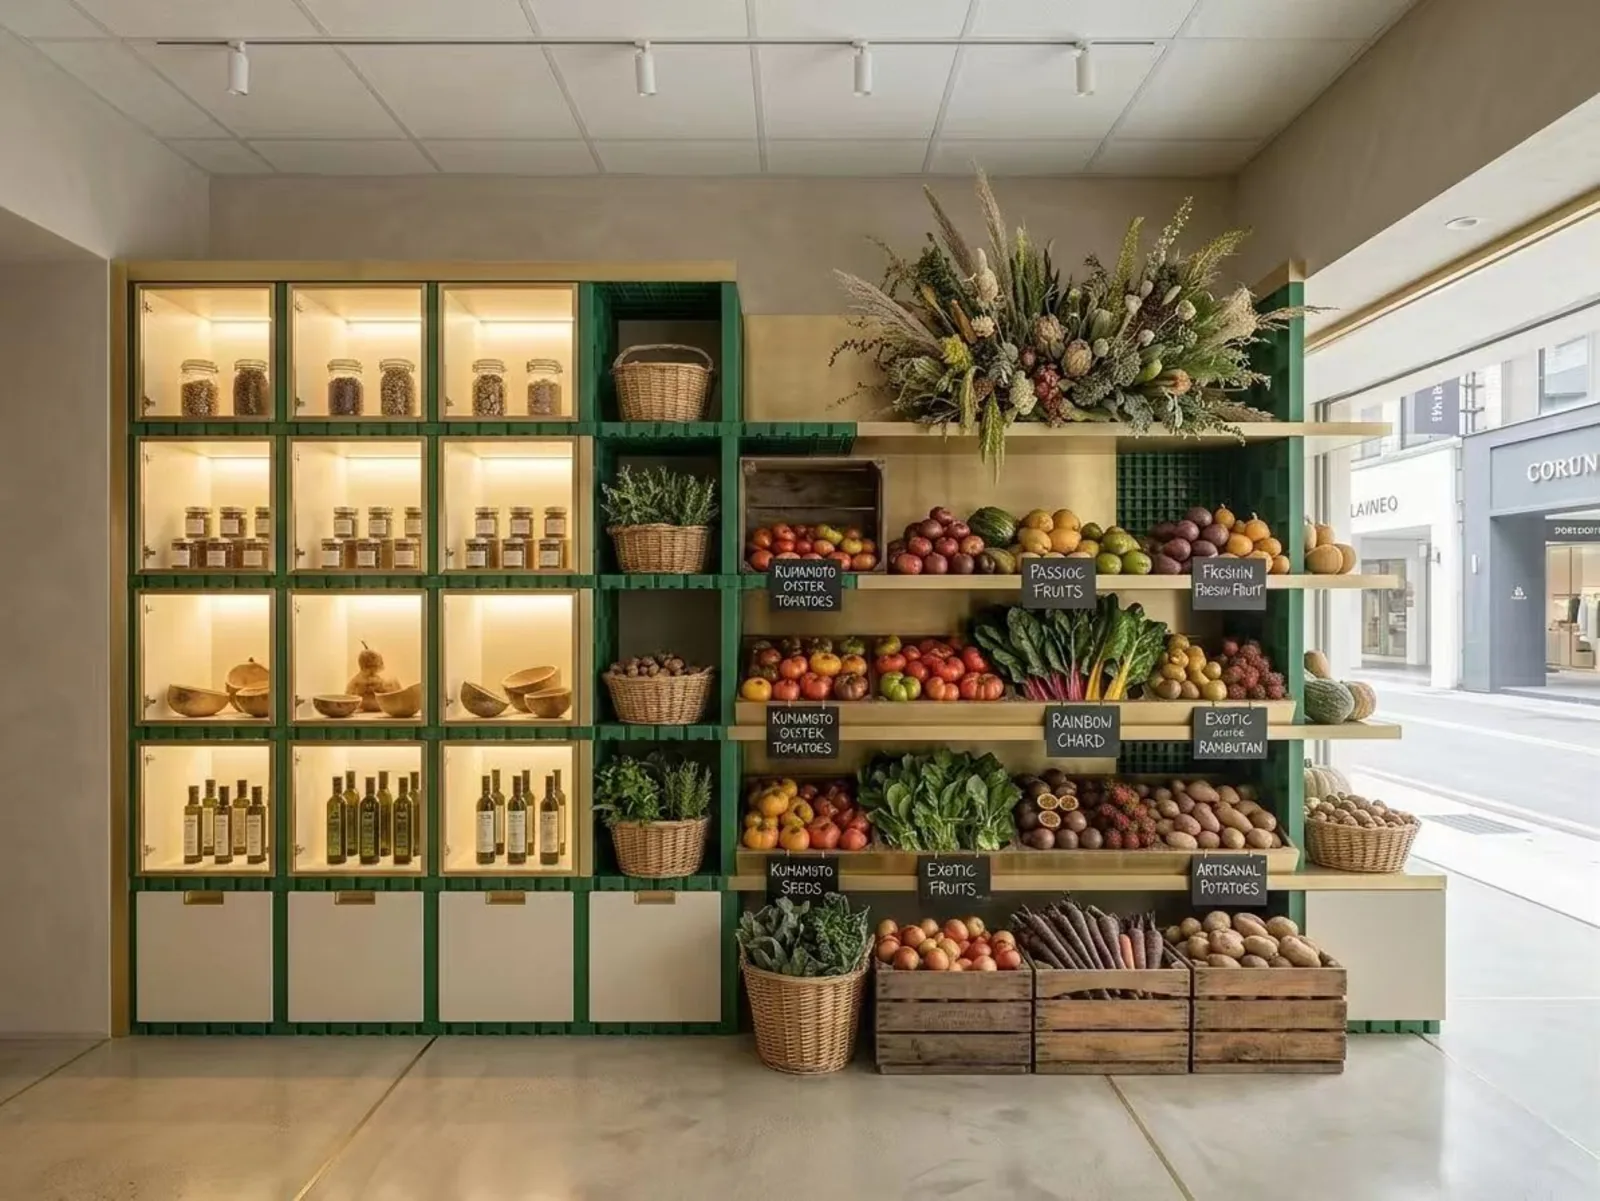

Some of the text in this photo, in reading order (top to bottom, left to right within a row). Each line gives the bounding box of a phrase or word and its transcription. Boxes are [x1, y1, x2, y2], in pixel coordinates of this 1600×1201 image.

[1032, 582, 1084, 599] FRUITS
[1205, 711, 1252, 726] EXOTIC
[1057, 732, 1105, 749] CHARD
[1199, 740, 1263, 754] RAMBUTAN
[1196, 862, 1262, 877] ARTISANAL
[928, 880, 977, 897] FRUITS
[1201, 878, 1260, 896] POTATOES
